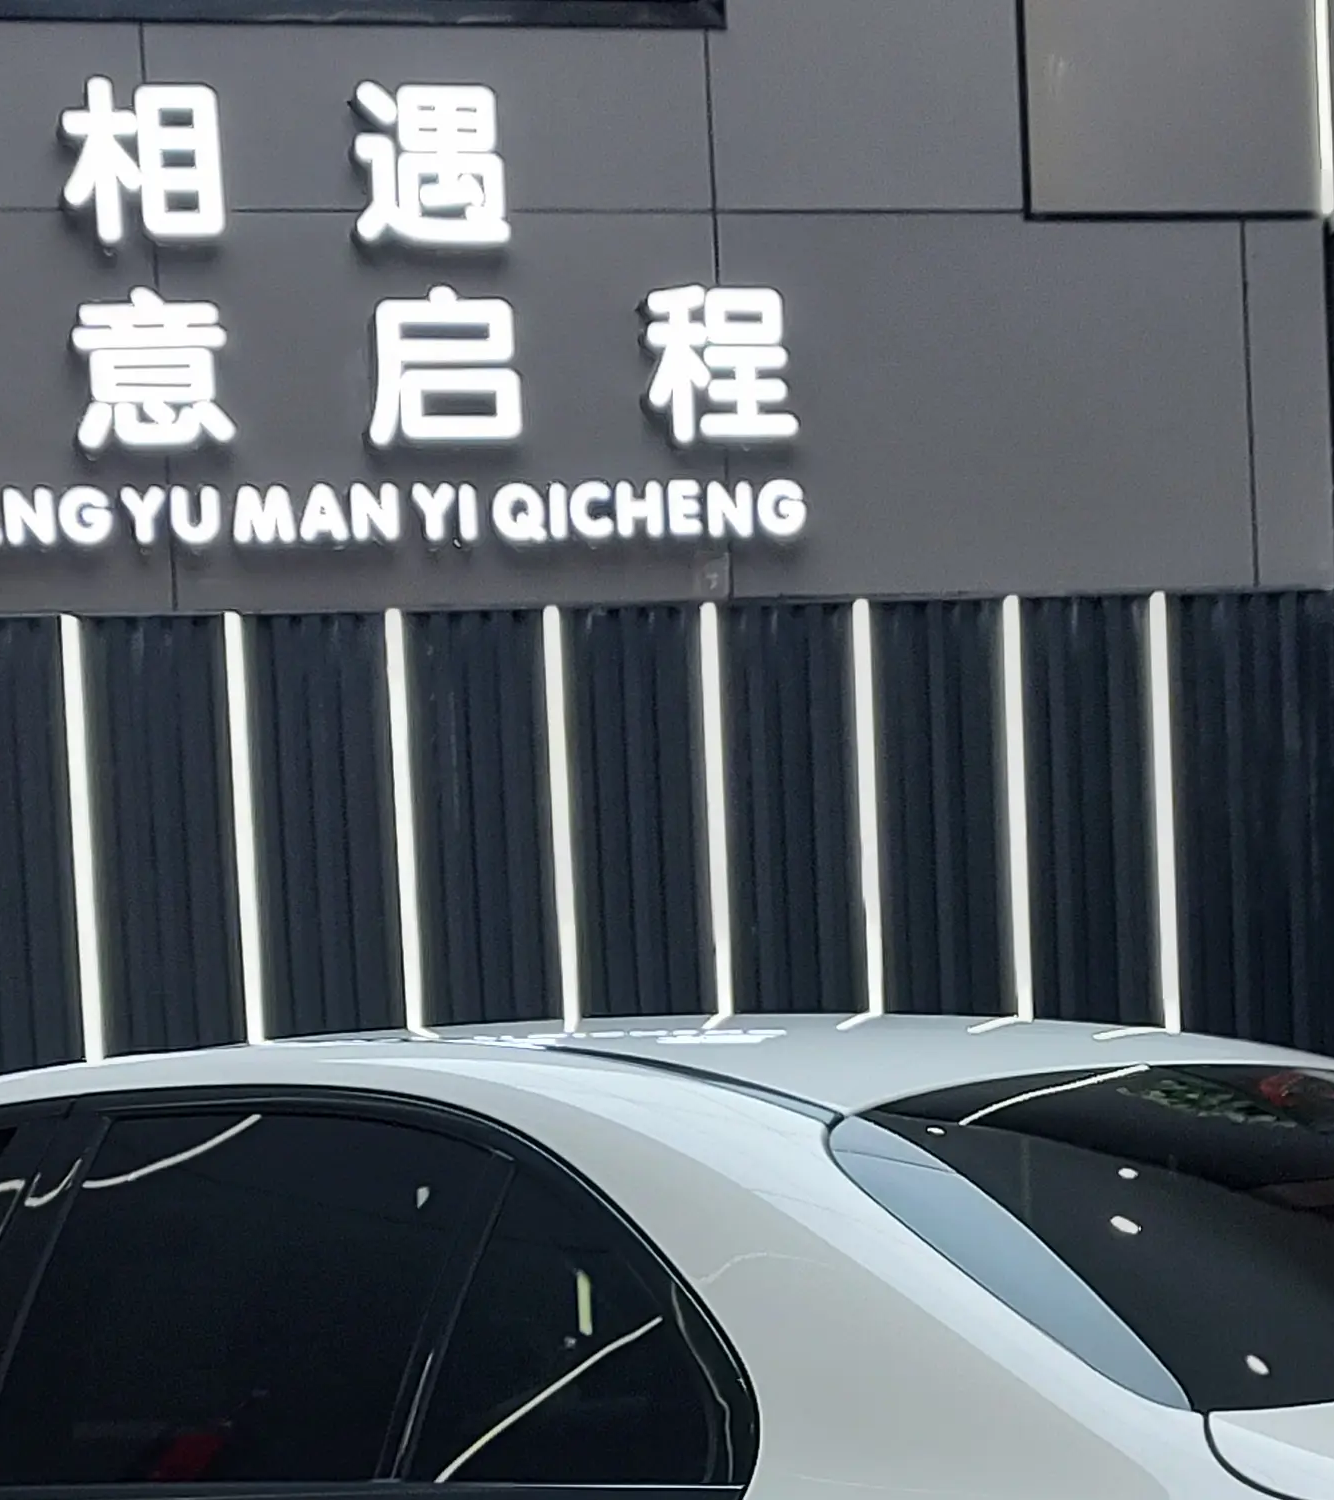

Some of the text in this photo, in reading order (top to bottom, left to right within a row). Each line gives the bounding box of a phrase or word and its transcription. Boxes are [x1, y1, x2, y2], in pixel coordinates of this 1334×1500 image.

[121, 486, 220, 543] YU
[234, 483, 400, 543] MAN
[412, 483, 477, 541] YI
